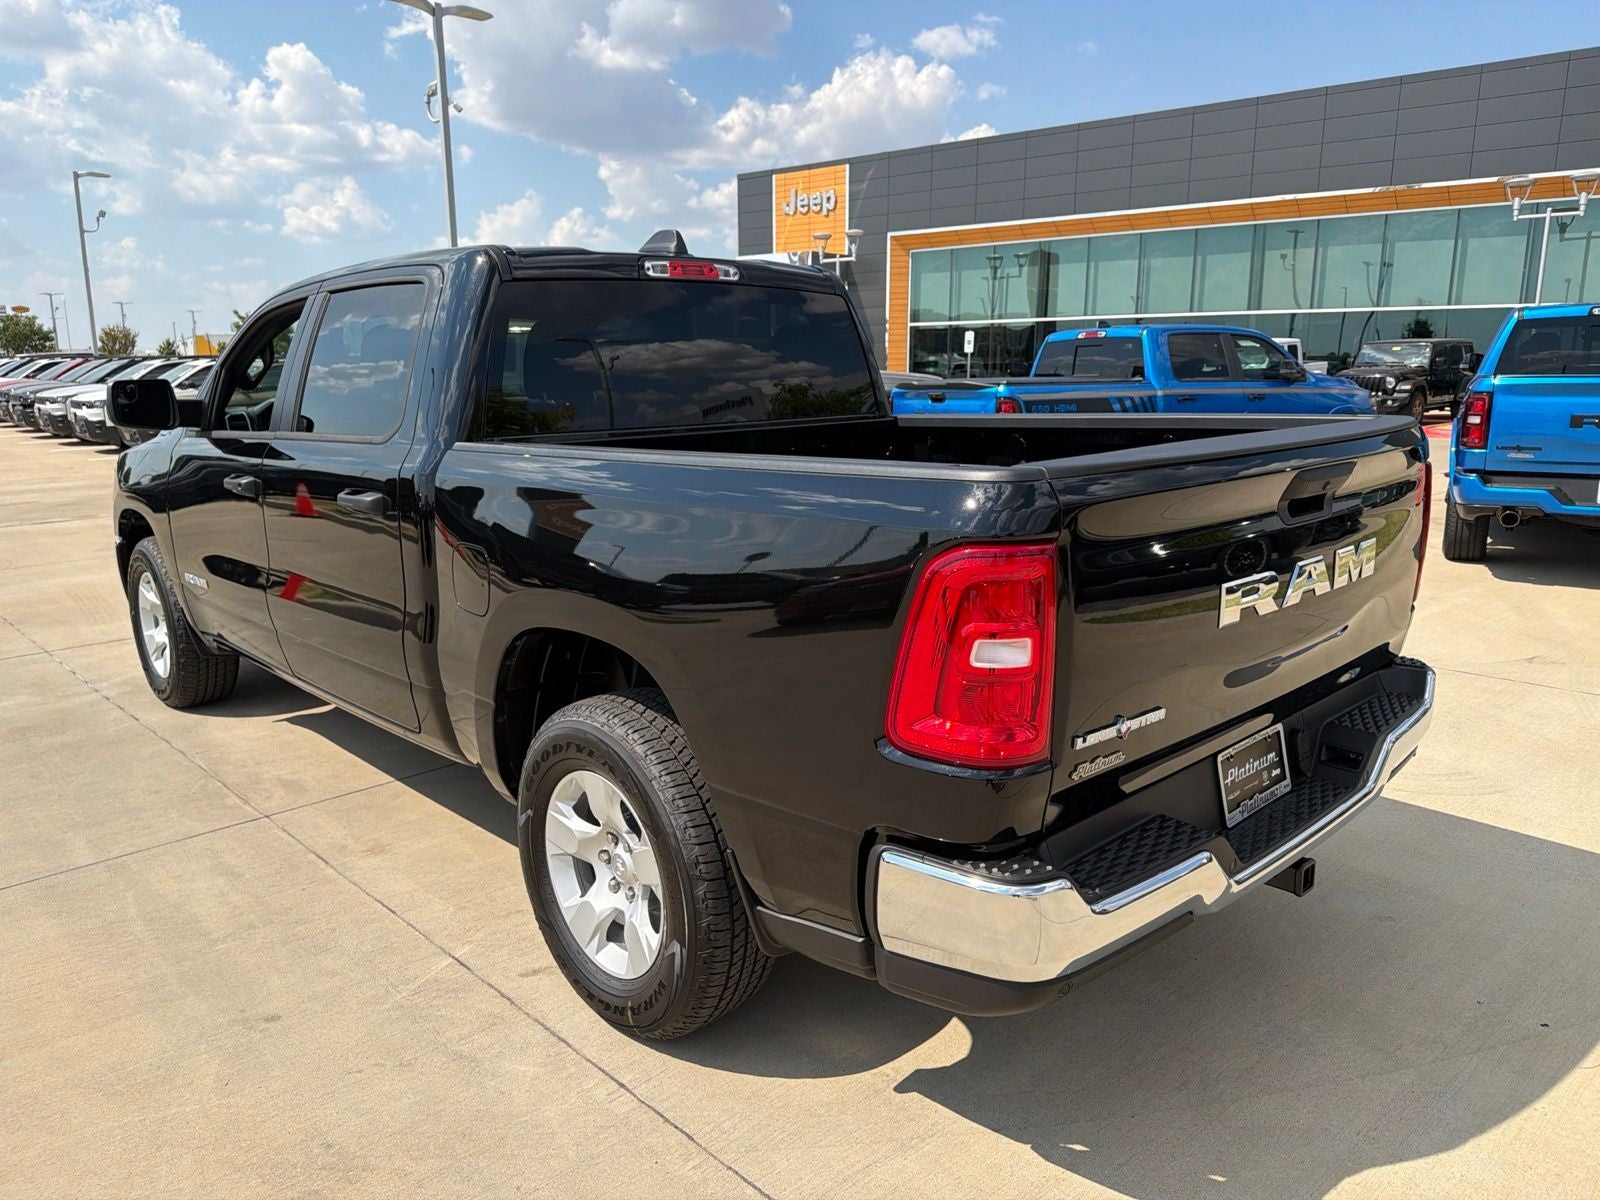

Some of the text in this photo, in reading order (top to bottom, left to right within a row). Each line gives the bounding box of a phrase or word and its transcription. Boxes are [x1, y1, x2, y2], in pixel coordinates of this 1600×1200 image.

[783, 187, 837, 217] Jeep
[1054, 404, 1077, 413] HEMI
[1217, 537, 1377, 629] RAM
[1073, 707, 1167, 751] LONE STAR
[1071, 750, 1126, 781] Platinum
[1224, 751, 1279, 787] Platinum
[1239, 788, 1279, 817] Platinum
